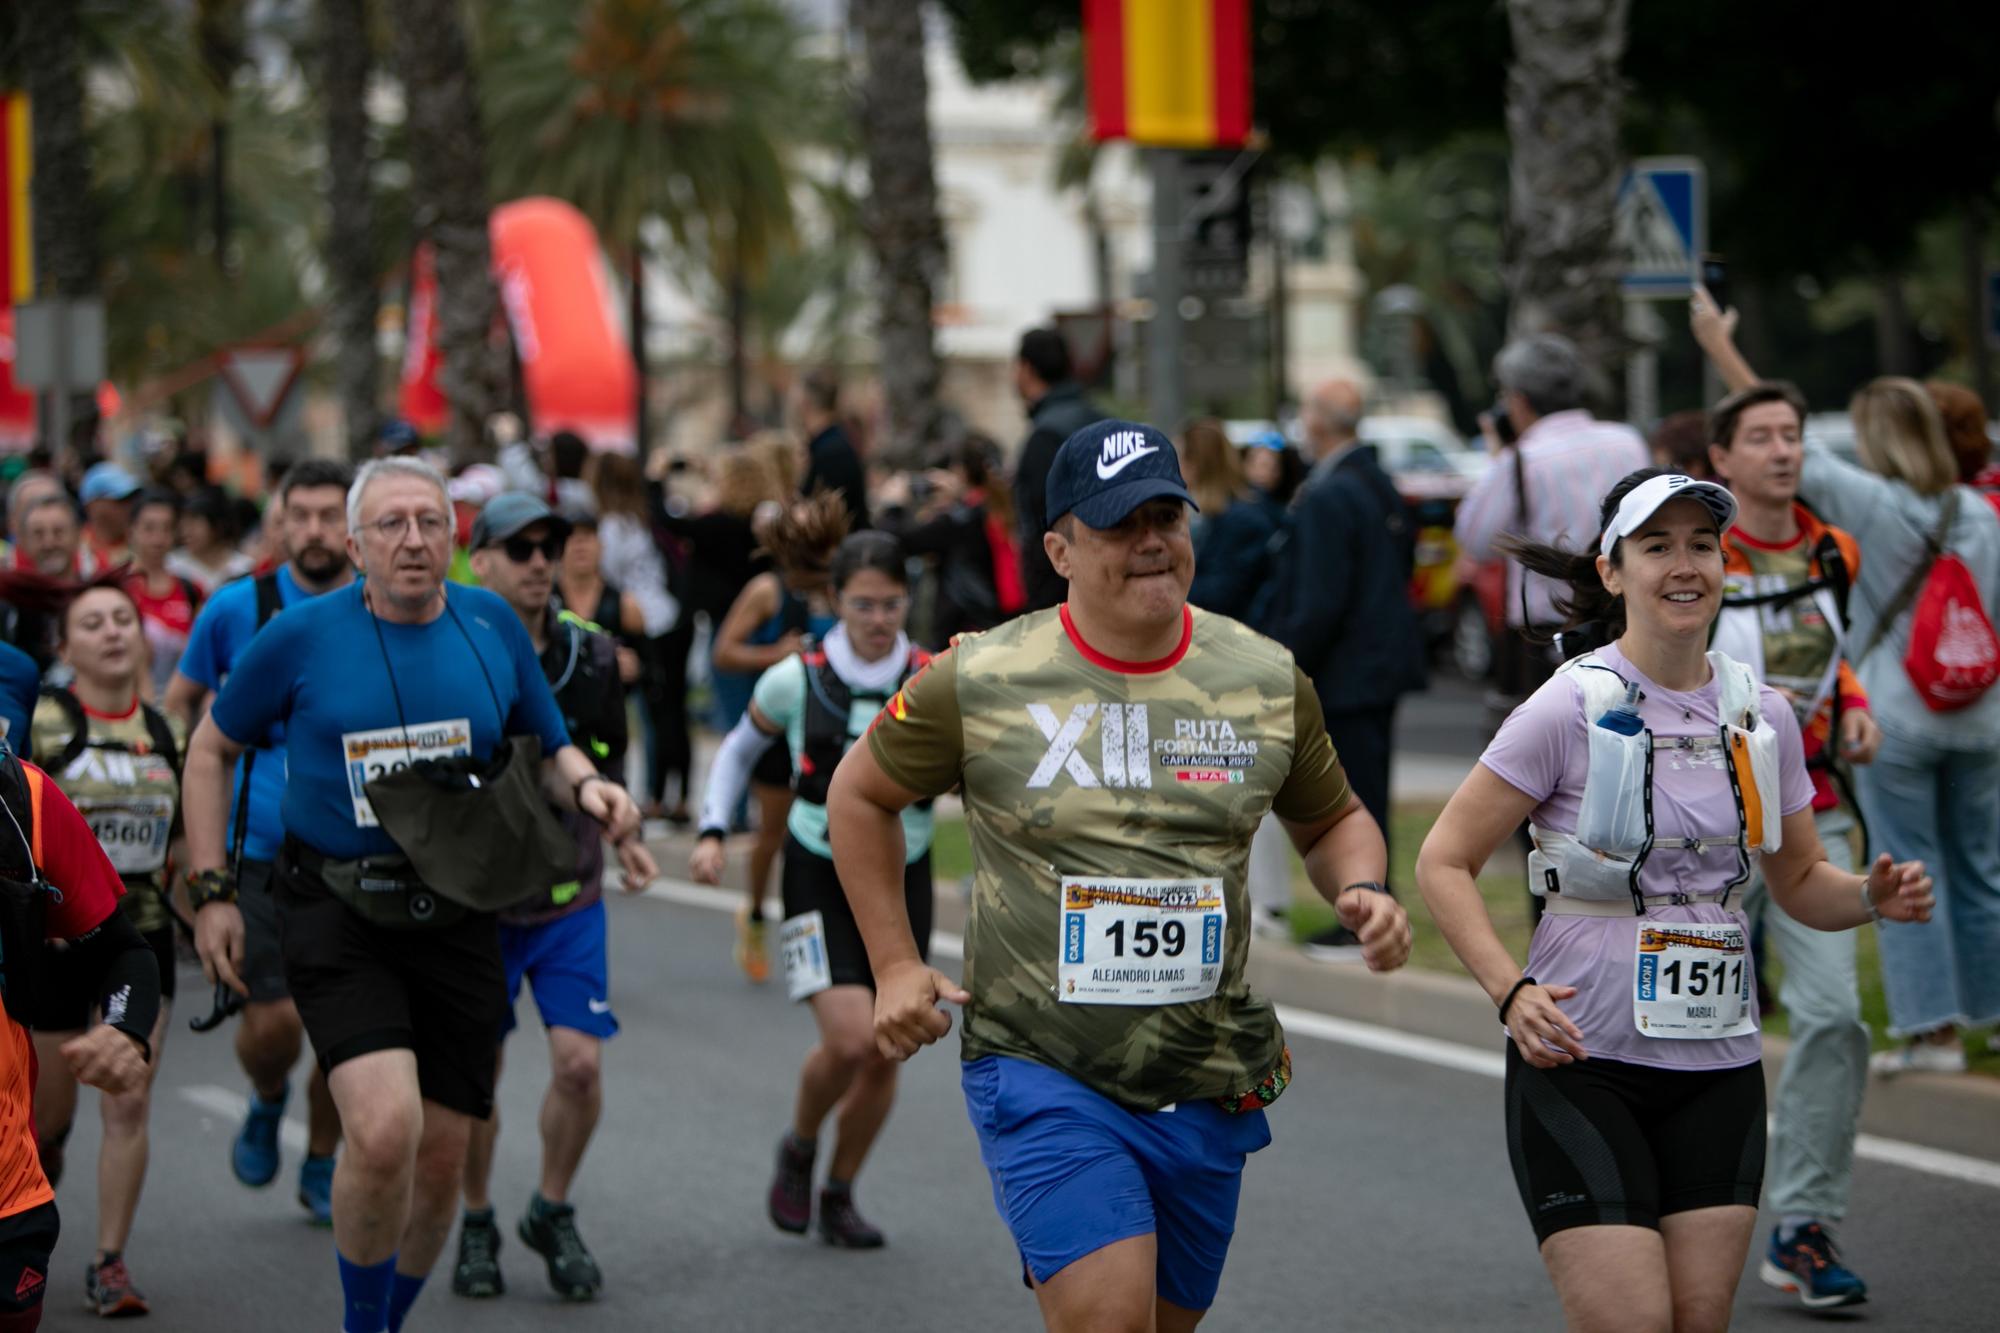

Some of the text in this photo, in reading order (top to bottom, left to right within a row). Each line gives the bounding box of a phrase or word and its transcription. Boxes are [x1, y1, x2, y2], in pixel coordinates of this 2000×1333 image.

[1103, 431, 1146, 463] NIKE
[1175, 719, 1236, 740] RUTA
[1025, 703, 1152, 788] XII
[1153, 739, 1258, 755] FORTALEZAS
[1161, 755, 1254, 767] CARTAGENA 2023
[1189, 771, 1228, 781] SPAR
[1125, 886, 1138, 897] DE
[1139, 887, 1159, 897] LAS
[1105, 919, 1186, 958] 159
[1092, 968, 1185, 983] ALEJANDRO LAMAS
[1641, 965, 1652, 999] CAJON
[1663, 959, 1742, 996] 1511
